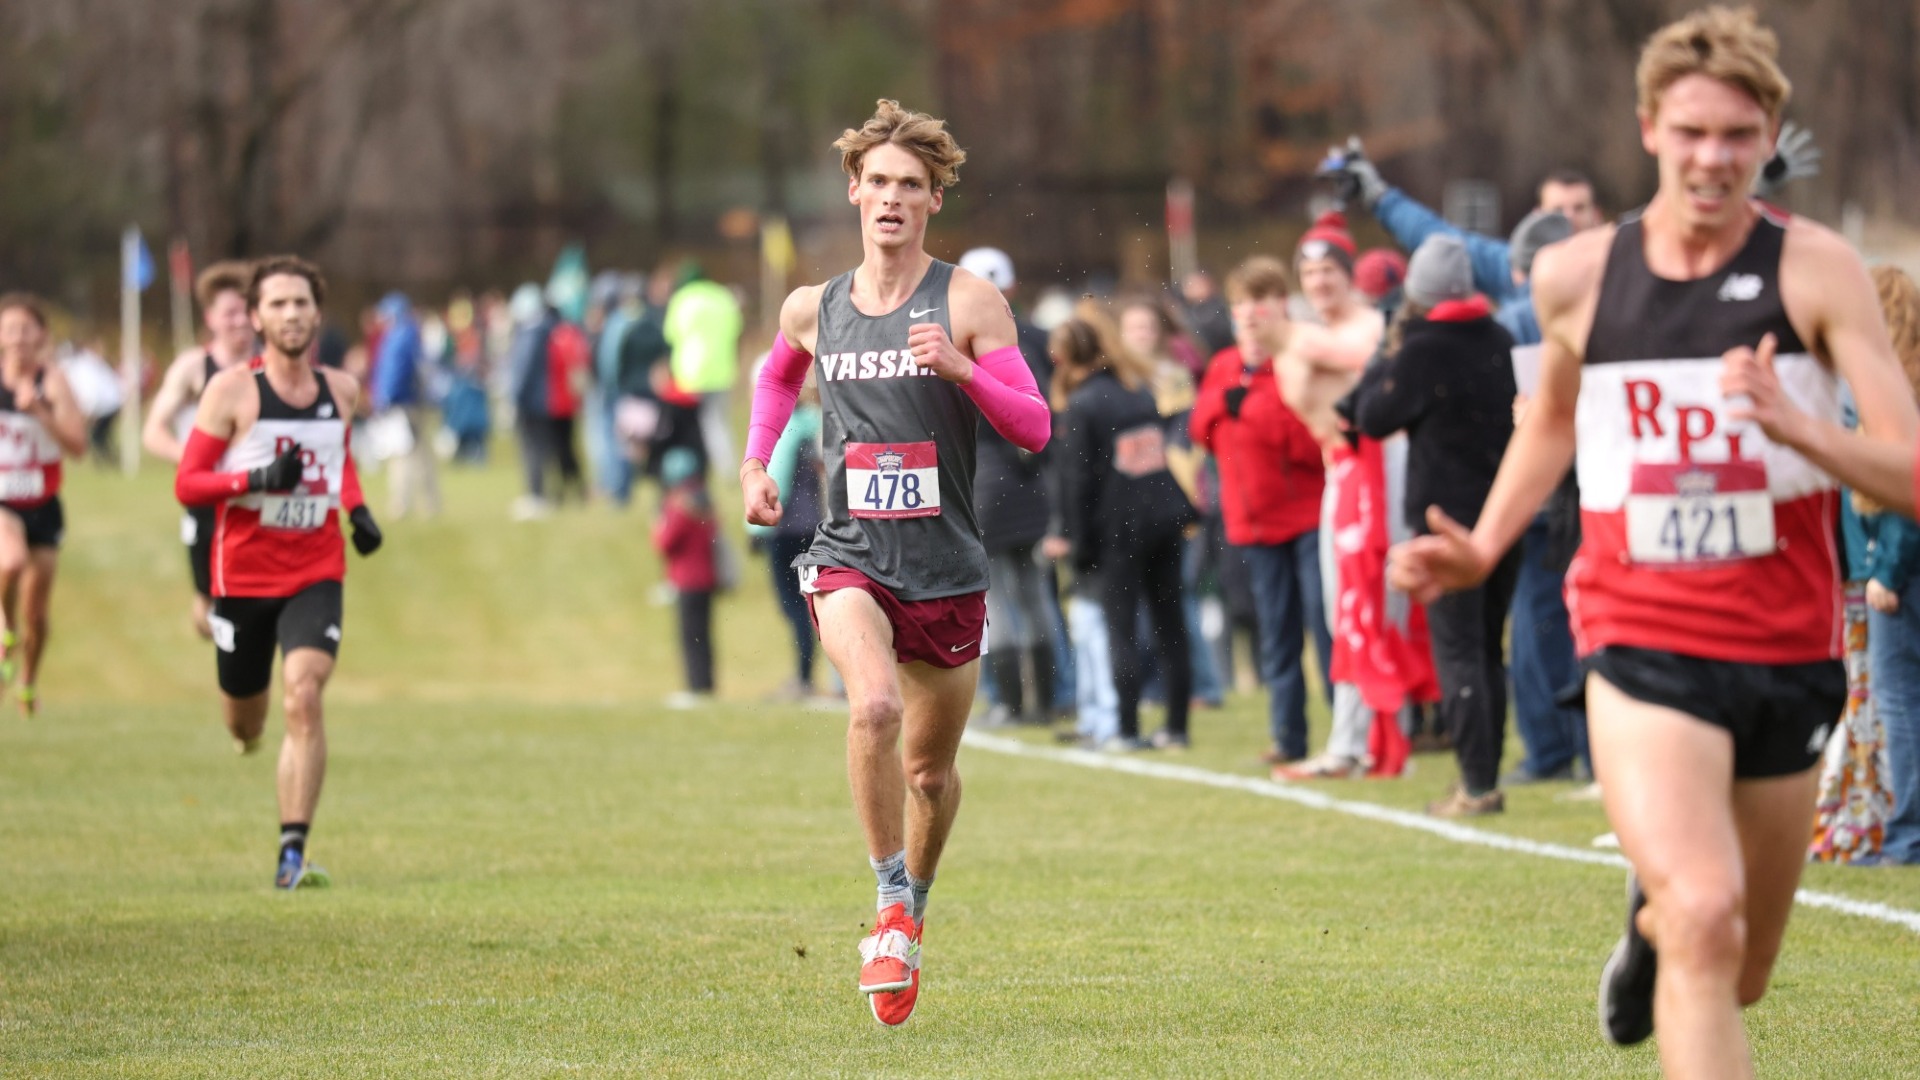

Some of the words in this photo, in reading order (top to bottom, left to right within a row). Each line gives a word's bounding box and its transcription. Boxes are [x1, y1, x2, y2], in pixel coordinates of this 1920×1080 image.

[820, 349, 938, 382] VASSA
[864, 473, 922, 509] 478
[276, 501, 316, 529] 431
[1659, 504, 1746, 561] 421
